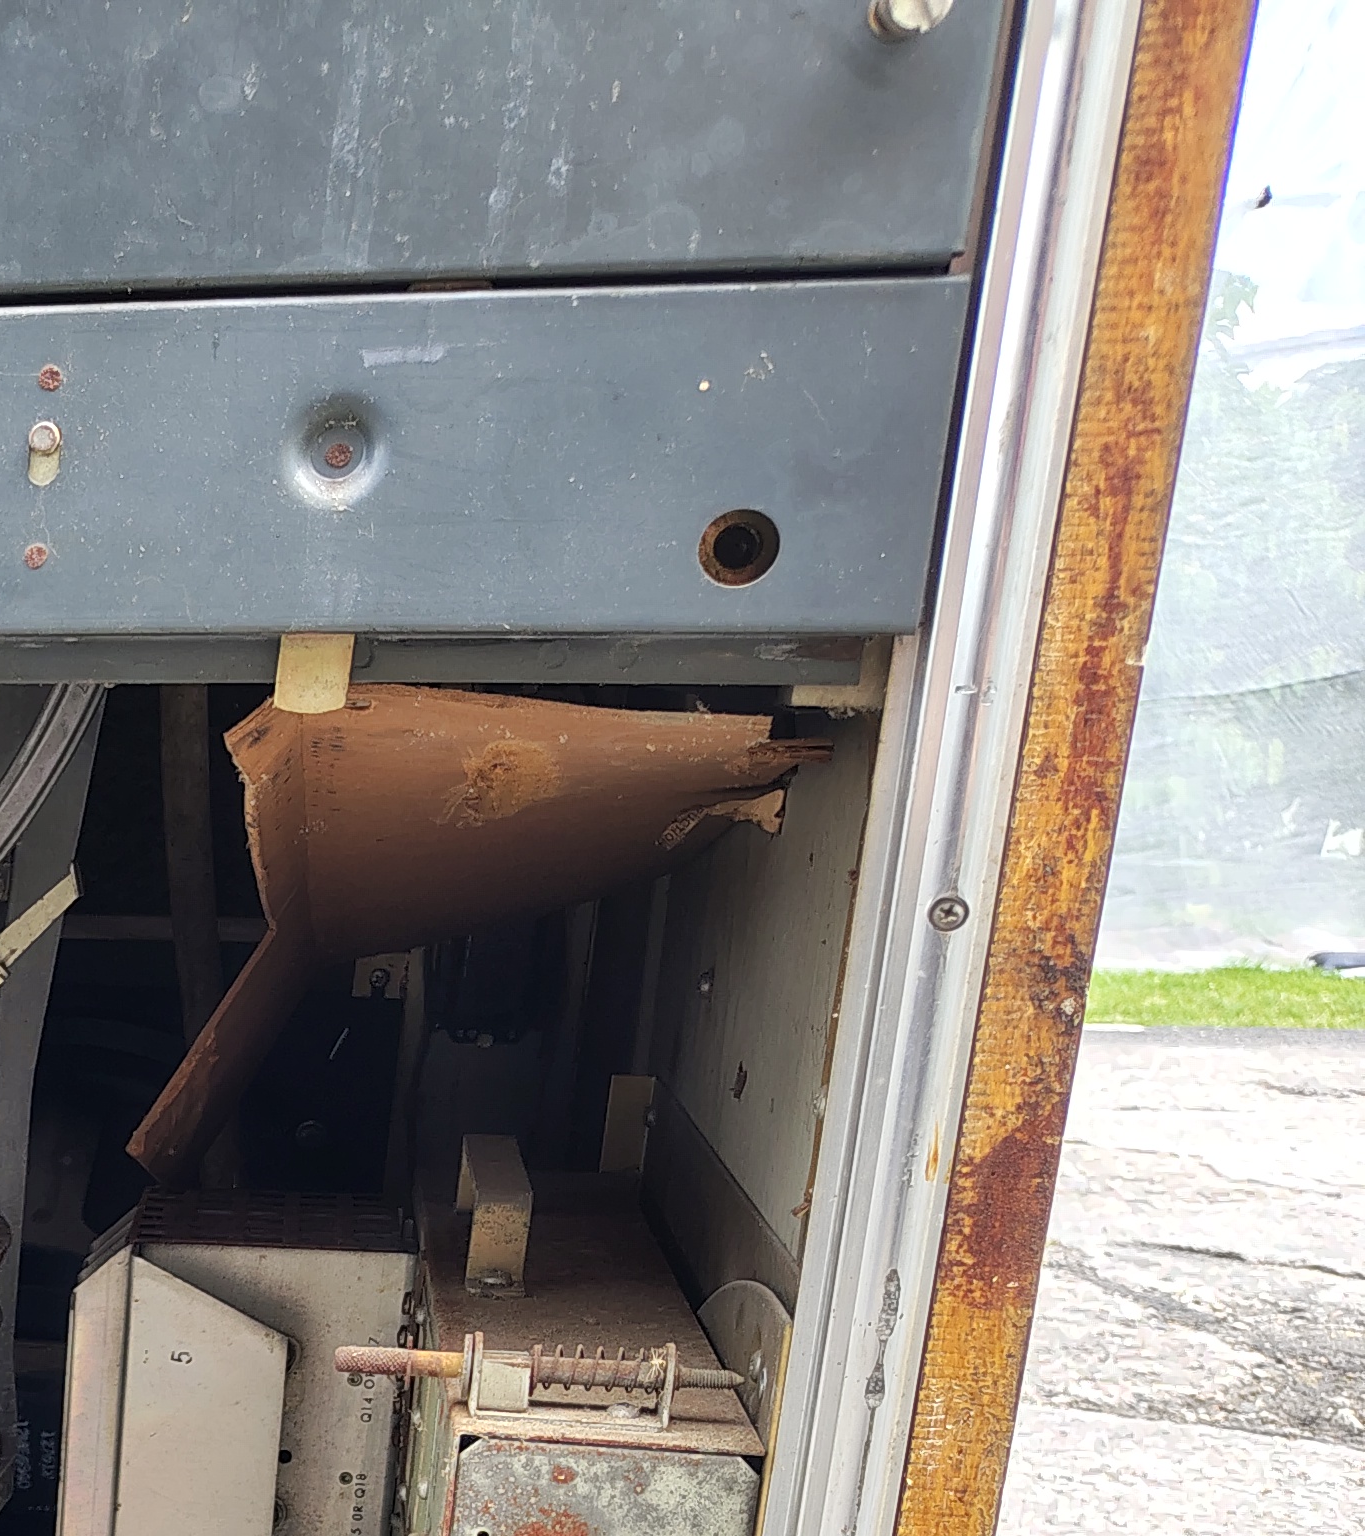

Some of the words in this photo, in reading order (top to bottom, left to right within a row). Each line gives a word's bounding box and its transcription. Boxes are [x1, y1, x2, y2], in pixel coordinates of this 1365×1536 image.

[361, 1398, 374, 1422] Q14
[354, 1473, 367, 1498] Q18
[352, 1506, 363, 1521] OR
